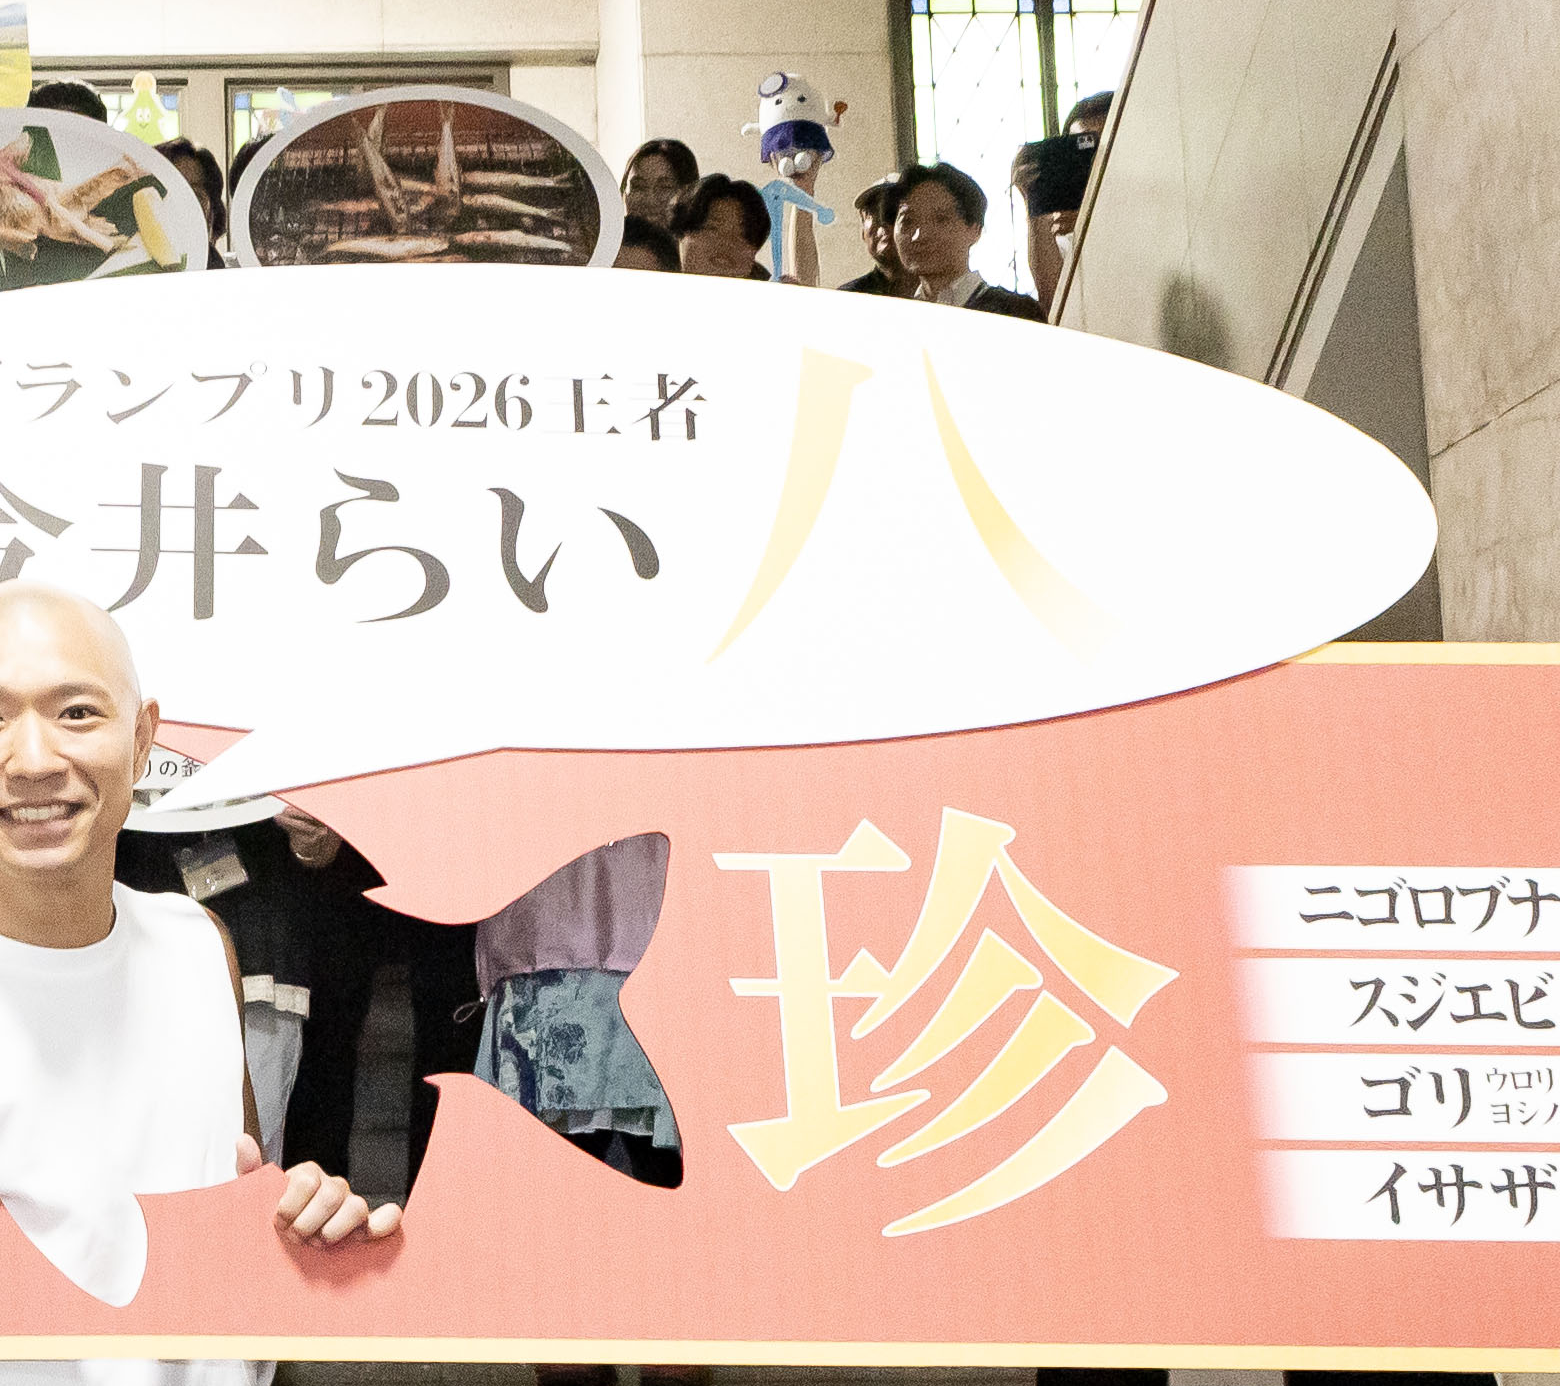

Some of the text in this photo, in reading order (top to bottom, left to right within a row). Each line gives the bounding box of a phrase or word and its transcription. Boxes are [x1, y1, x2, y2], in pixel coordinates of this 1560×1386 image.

[1298, 875, 1560, 938] ニゴロブナ
[711, 805, 1181, 1238] 珍
[1349, 971, 1556, 1032] スジエビ
[1361, 1065, 1472, 1129] ゴリ
[1486, 1067, 1553, 1093] ウロリ
[1365, 1162, 1558, 1229] イサザ
